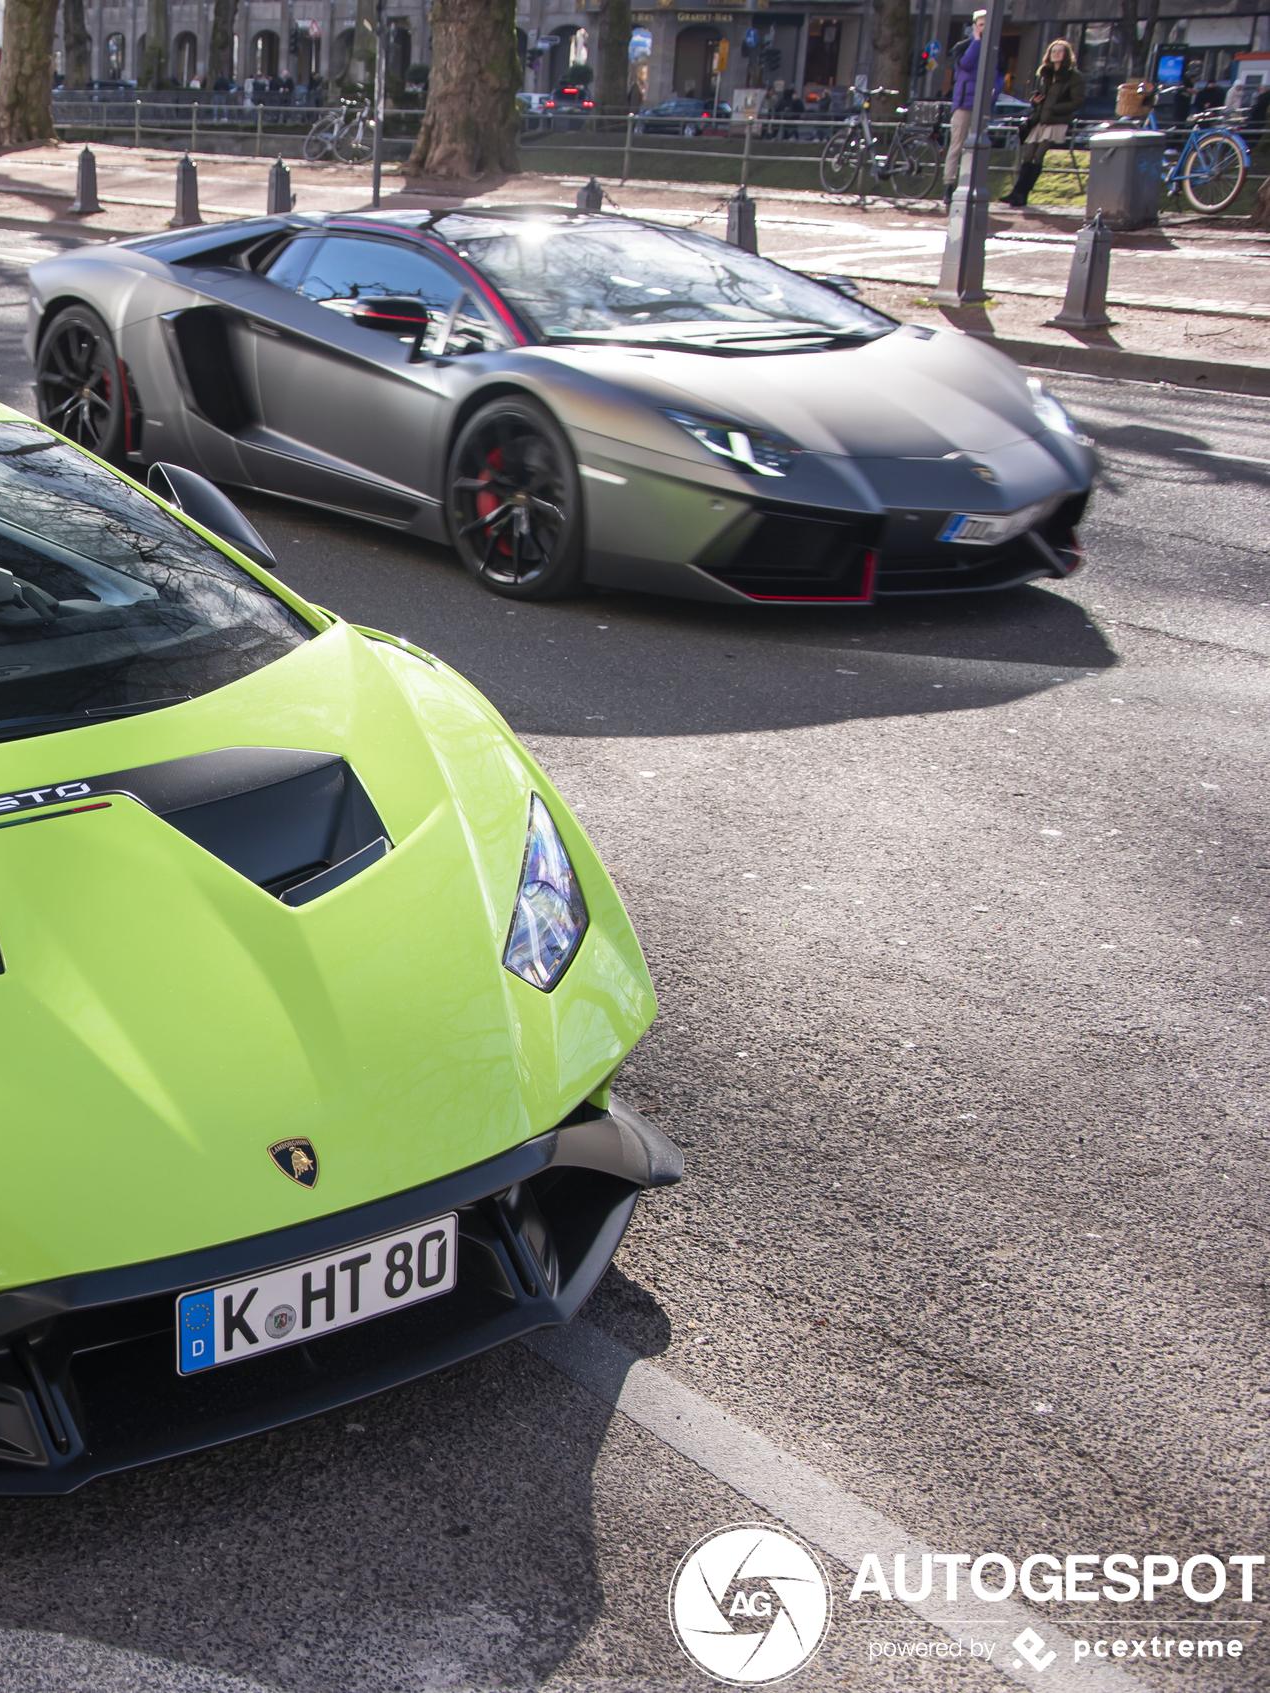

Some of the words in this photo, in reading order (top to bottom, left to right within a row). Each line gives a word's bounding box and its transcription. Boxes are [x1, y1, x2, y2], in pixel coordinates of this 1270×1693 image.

[270, 1139, 310, 1156] LAMBORGHINI
[223, 1286, 260, 1352] K
[301, 1252, 372, 1329] HT
[384, 1229, 448, 1299] 80
[192, 1339, 205, 1357] D
